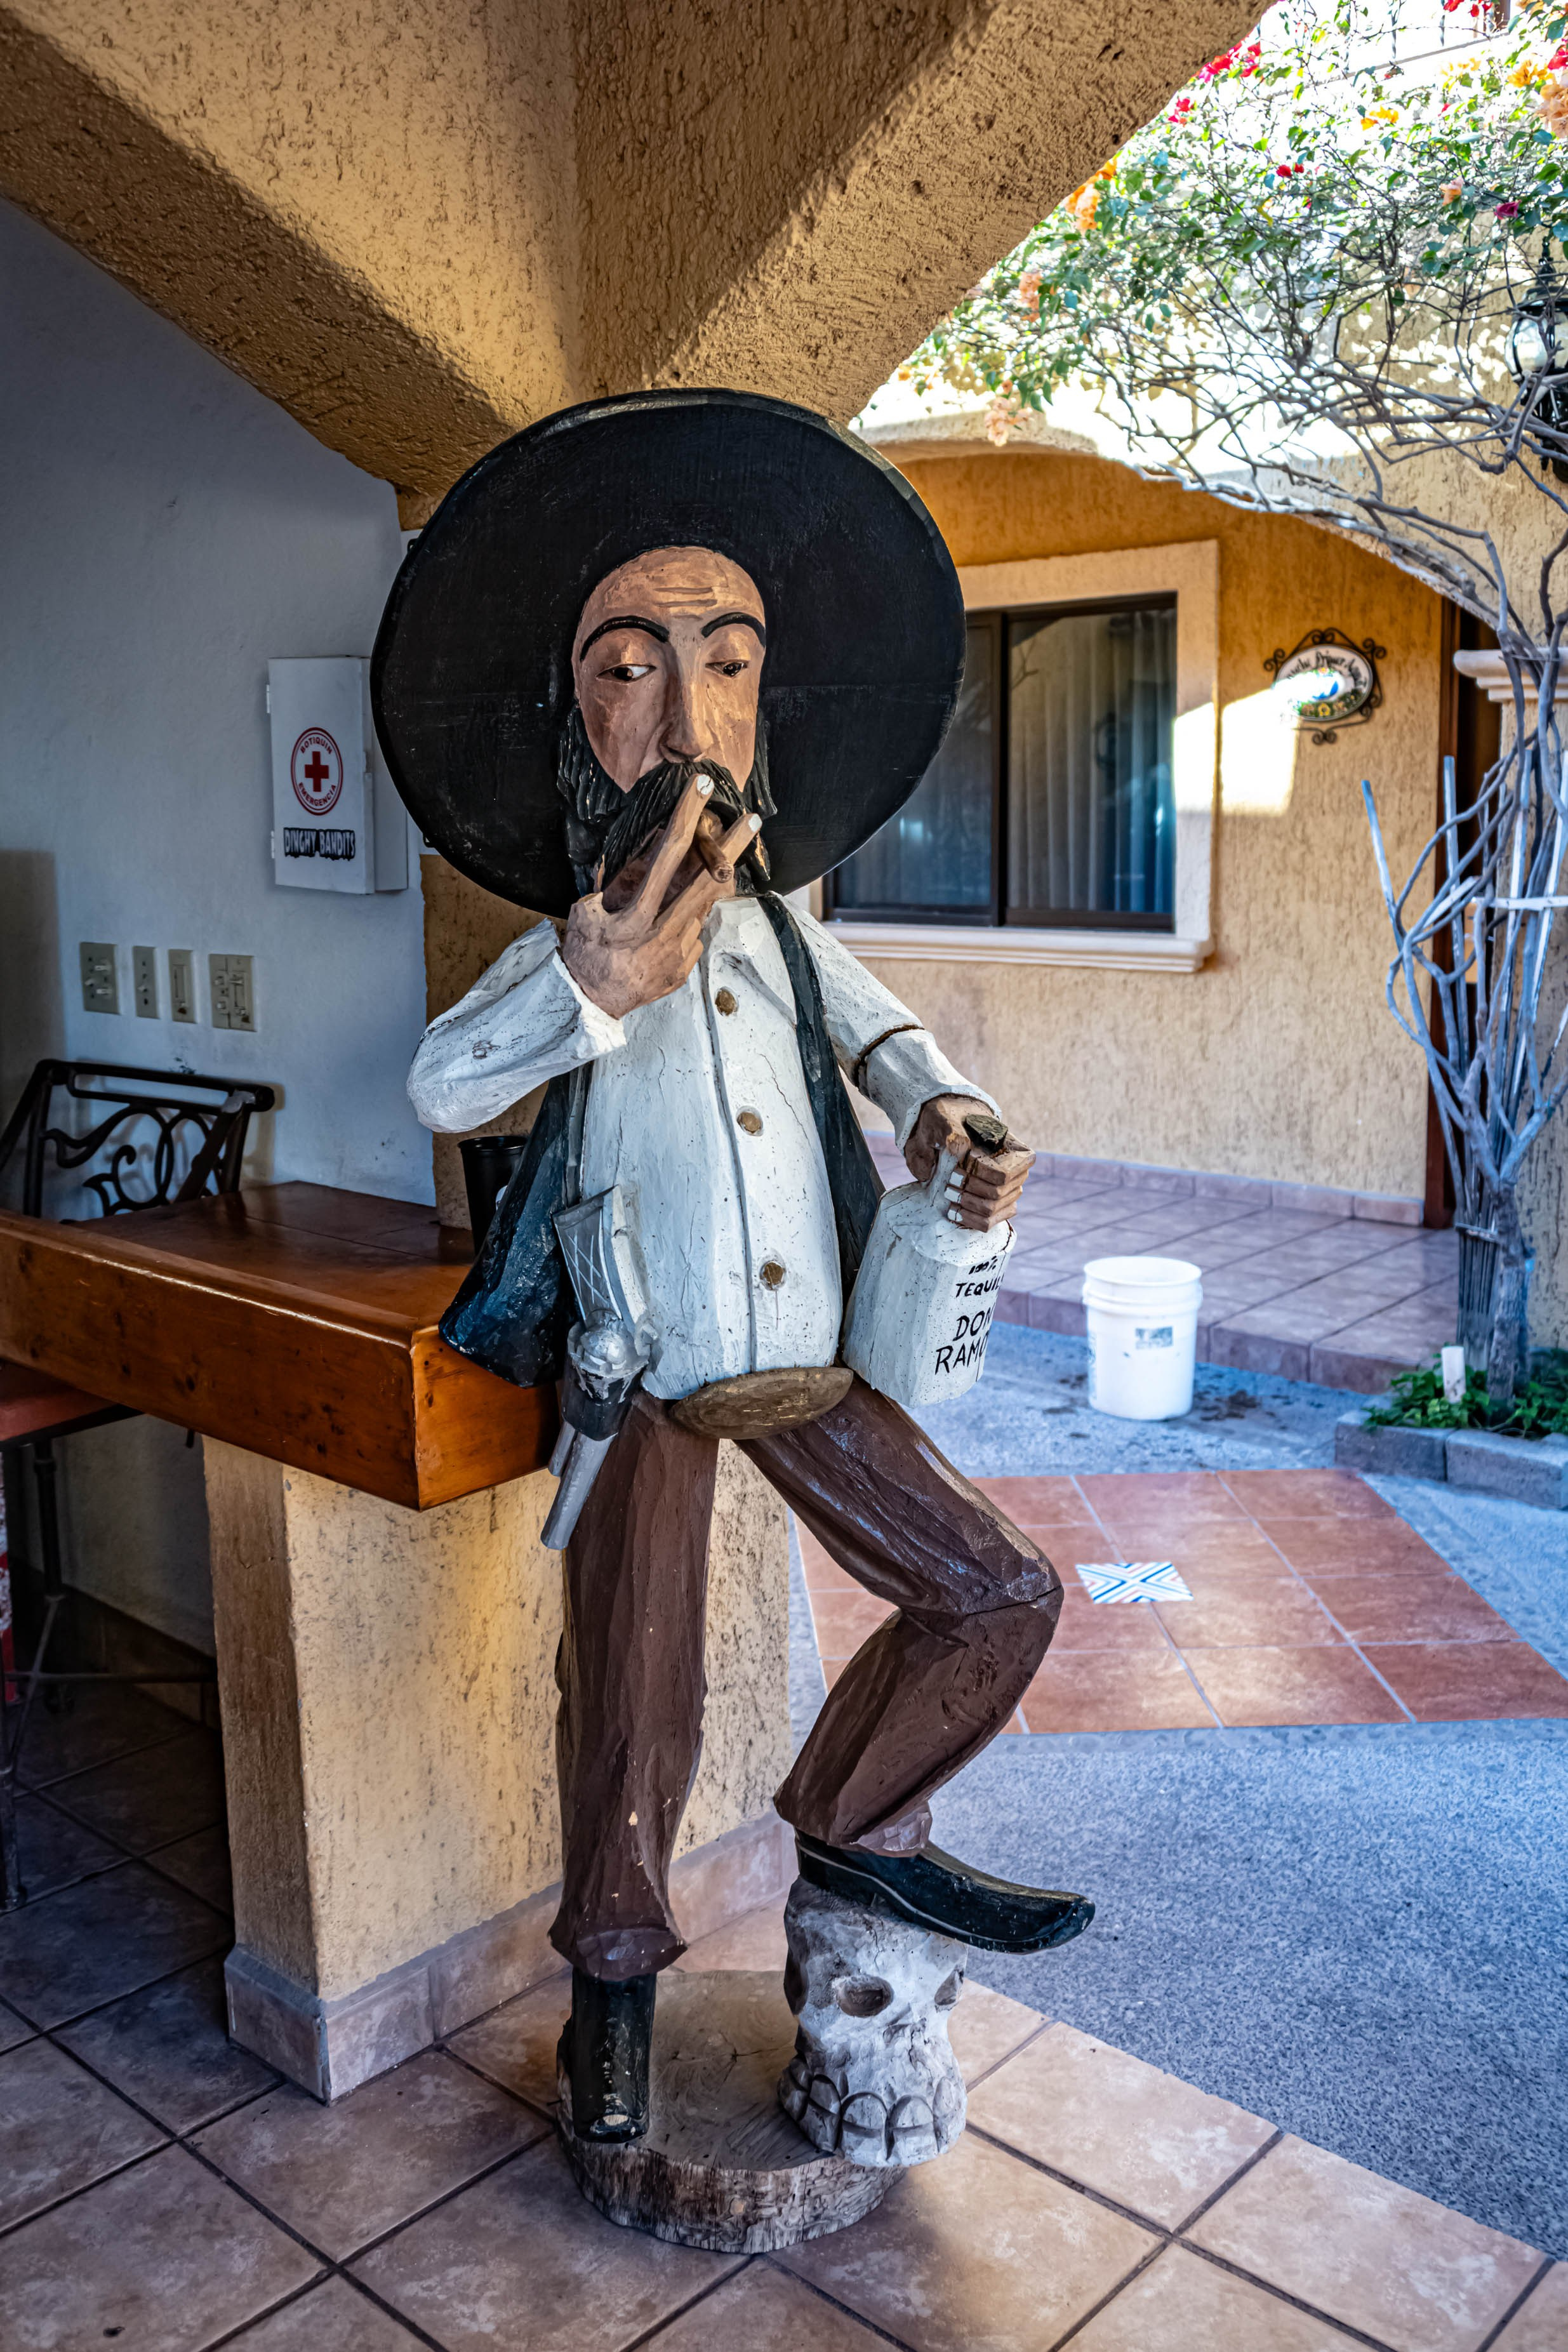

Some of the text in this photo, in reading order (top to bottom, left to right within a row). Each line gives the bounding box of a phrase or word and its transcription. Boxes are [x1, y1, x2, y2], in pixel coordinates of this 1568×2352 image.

[300, 736, 333, 755] BOTIQUIN
[298, 781, 336, 806] EMERGENCIA
[284, 829, 355, 857] DINGHY BANDITS
[952, 1303, 996, 1341] DON
[935, 1331, 990, 1374] RAMO
